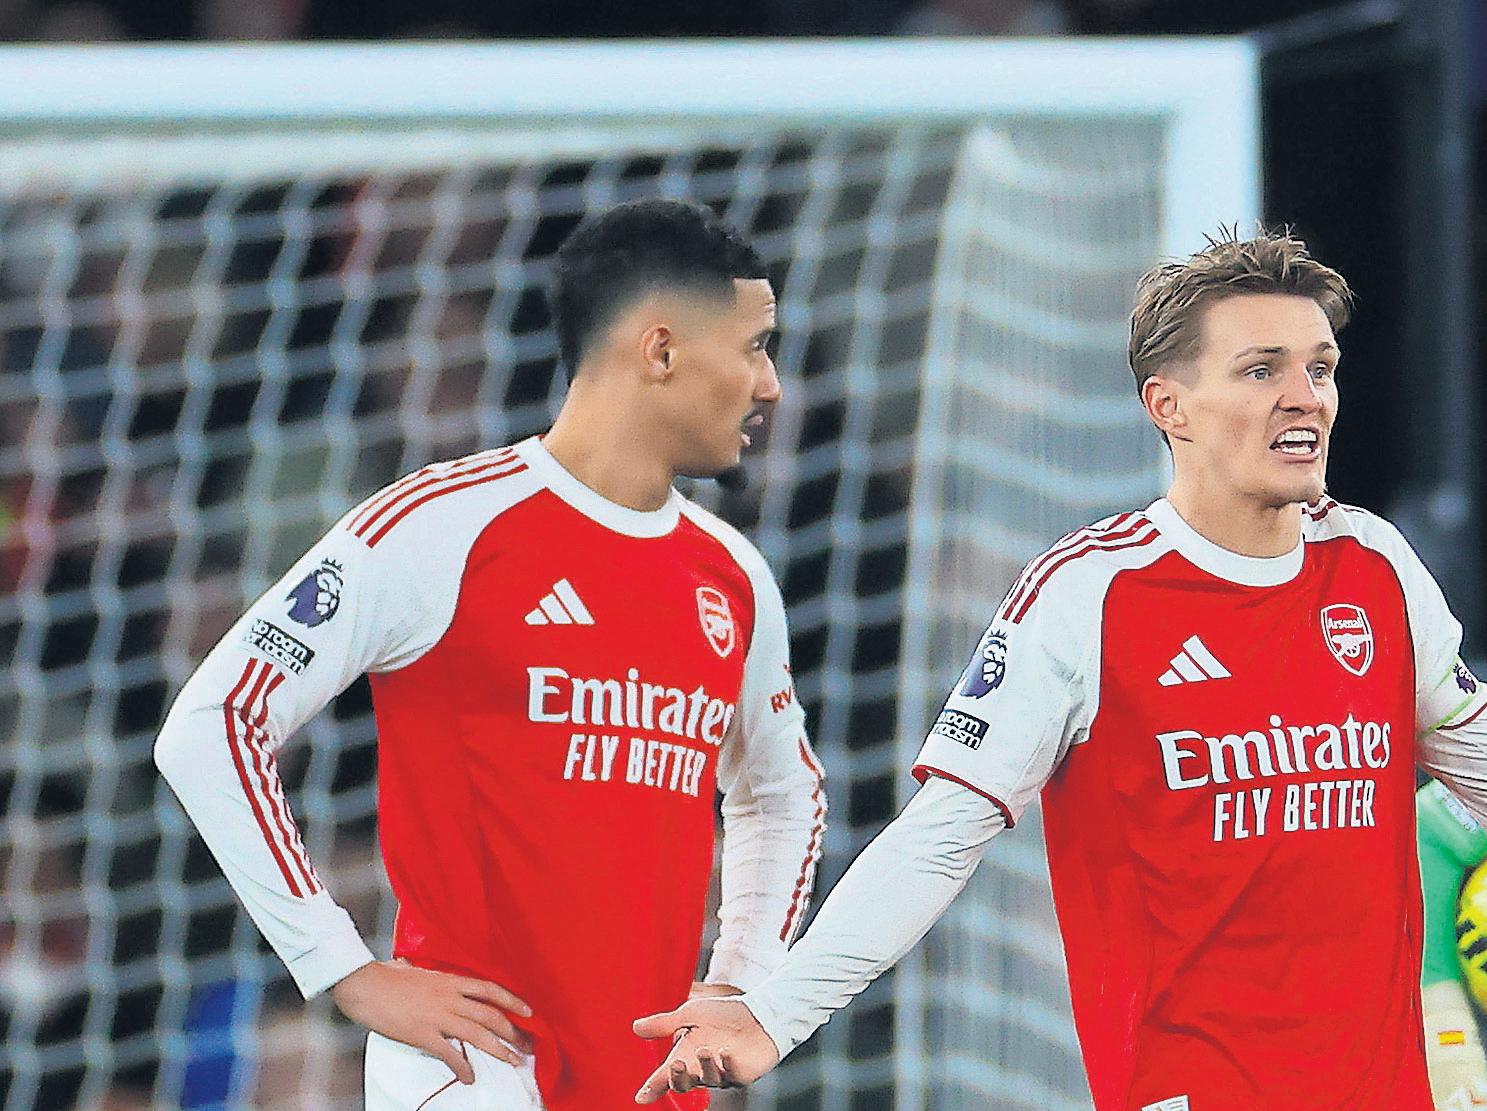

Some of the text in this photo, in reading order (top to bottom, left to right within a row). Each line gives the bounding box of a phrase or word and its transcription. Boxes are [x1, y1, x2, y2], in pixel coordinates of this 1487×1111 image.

[267, 628, 308, 660] room
[1328, 616, 1364, 629] Arsenal
[563, 733, 706, 798] FLY BETTER
[1156, 714, 1392, 791] Emirates
[1213, 787, 1272, 842] FLY
[1283, 779, 1376, 833] BETTER
